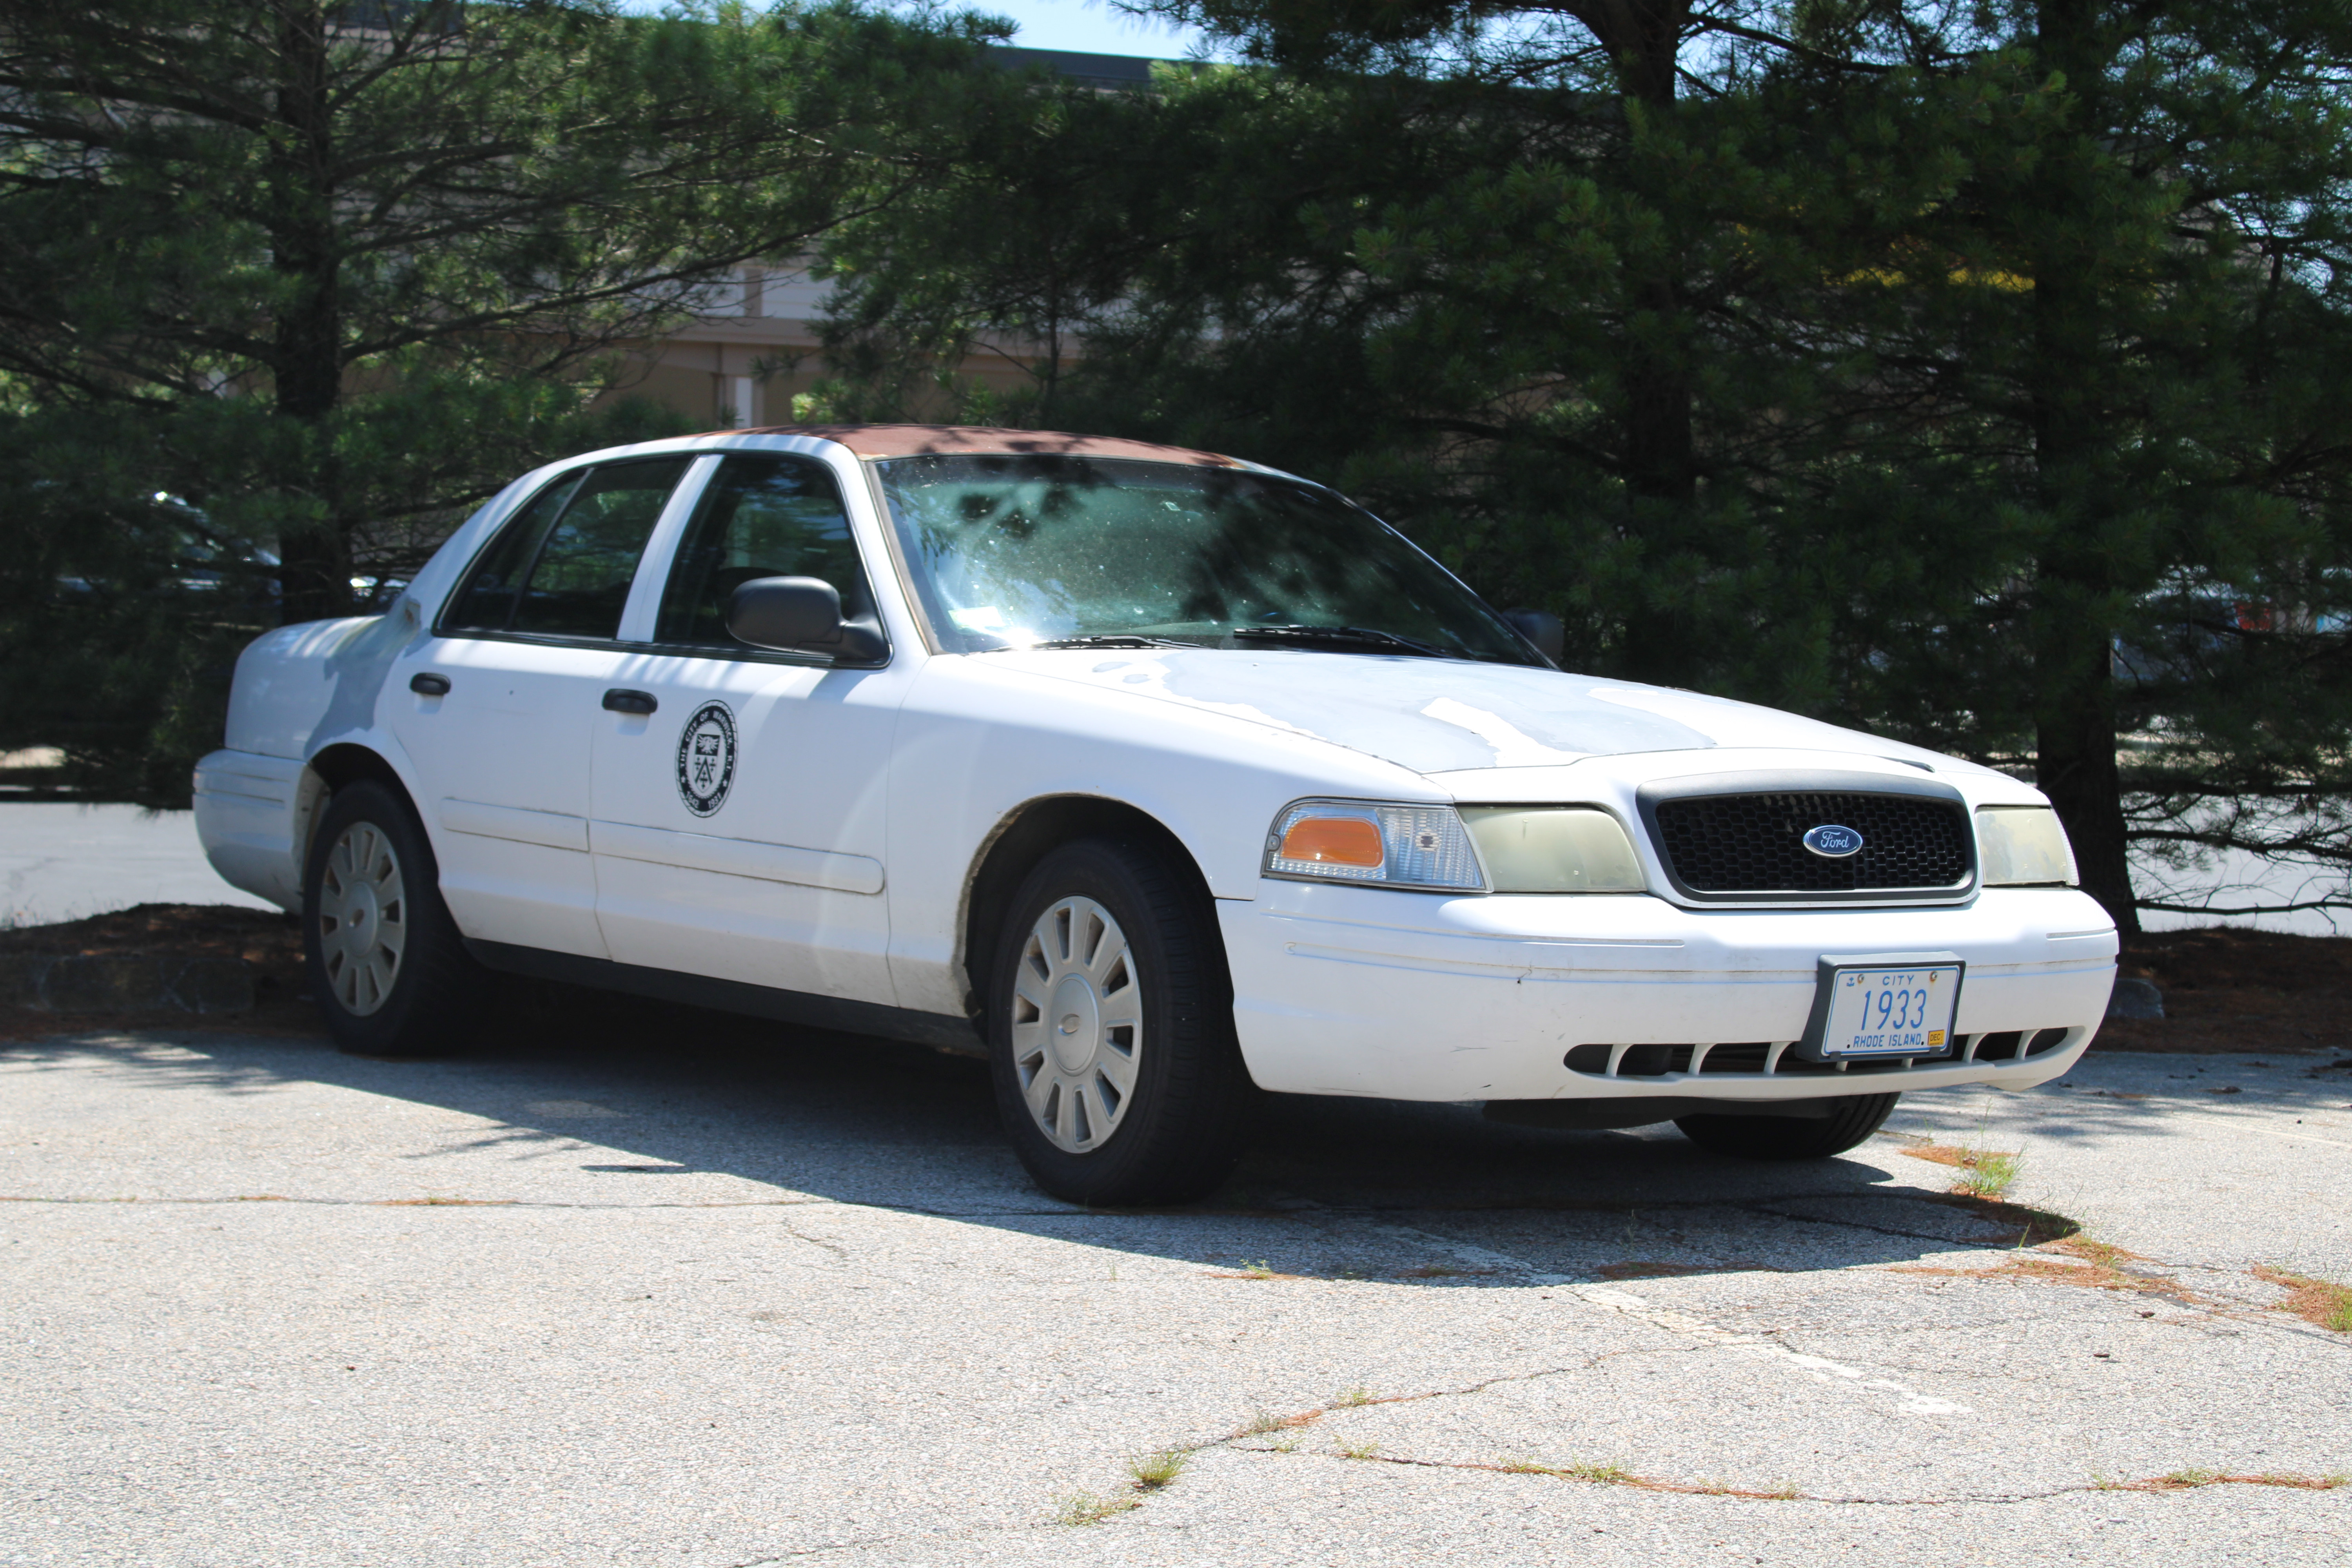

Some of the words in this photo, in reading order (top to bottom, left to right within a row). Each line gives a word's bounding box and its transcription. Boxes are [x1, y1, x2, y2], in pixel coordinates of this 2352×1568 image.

[685, 720, 697, 742] CITY
[700, 711, 709, 722] OF
[1820, 831, 1849, 848] Ford
[1882, 975, 1915, 986] CITY
[1861, 989, 1927, 1031] 1933
[1853, 1034, 1885, 1048] RHODE
[1888, 1033, 1921, 1046] ISLAND
[1930, 1033, 1940, 1042] DEC
